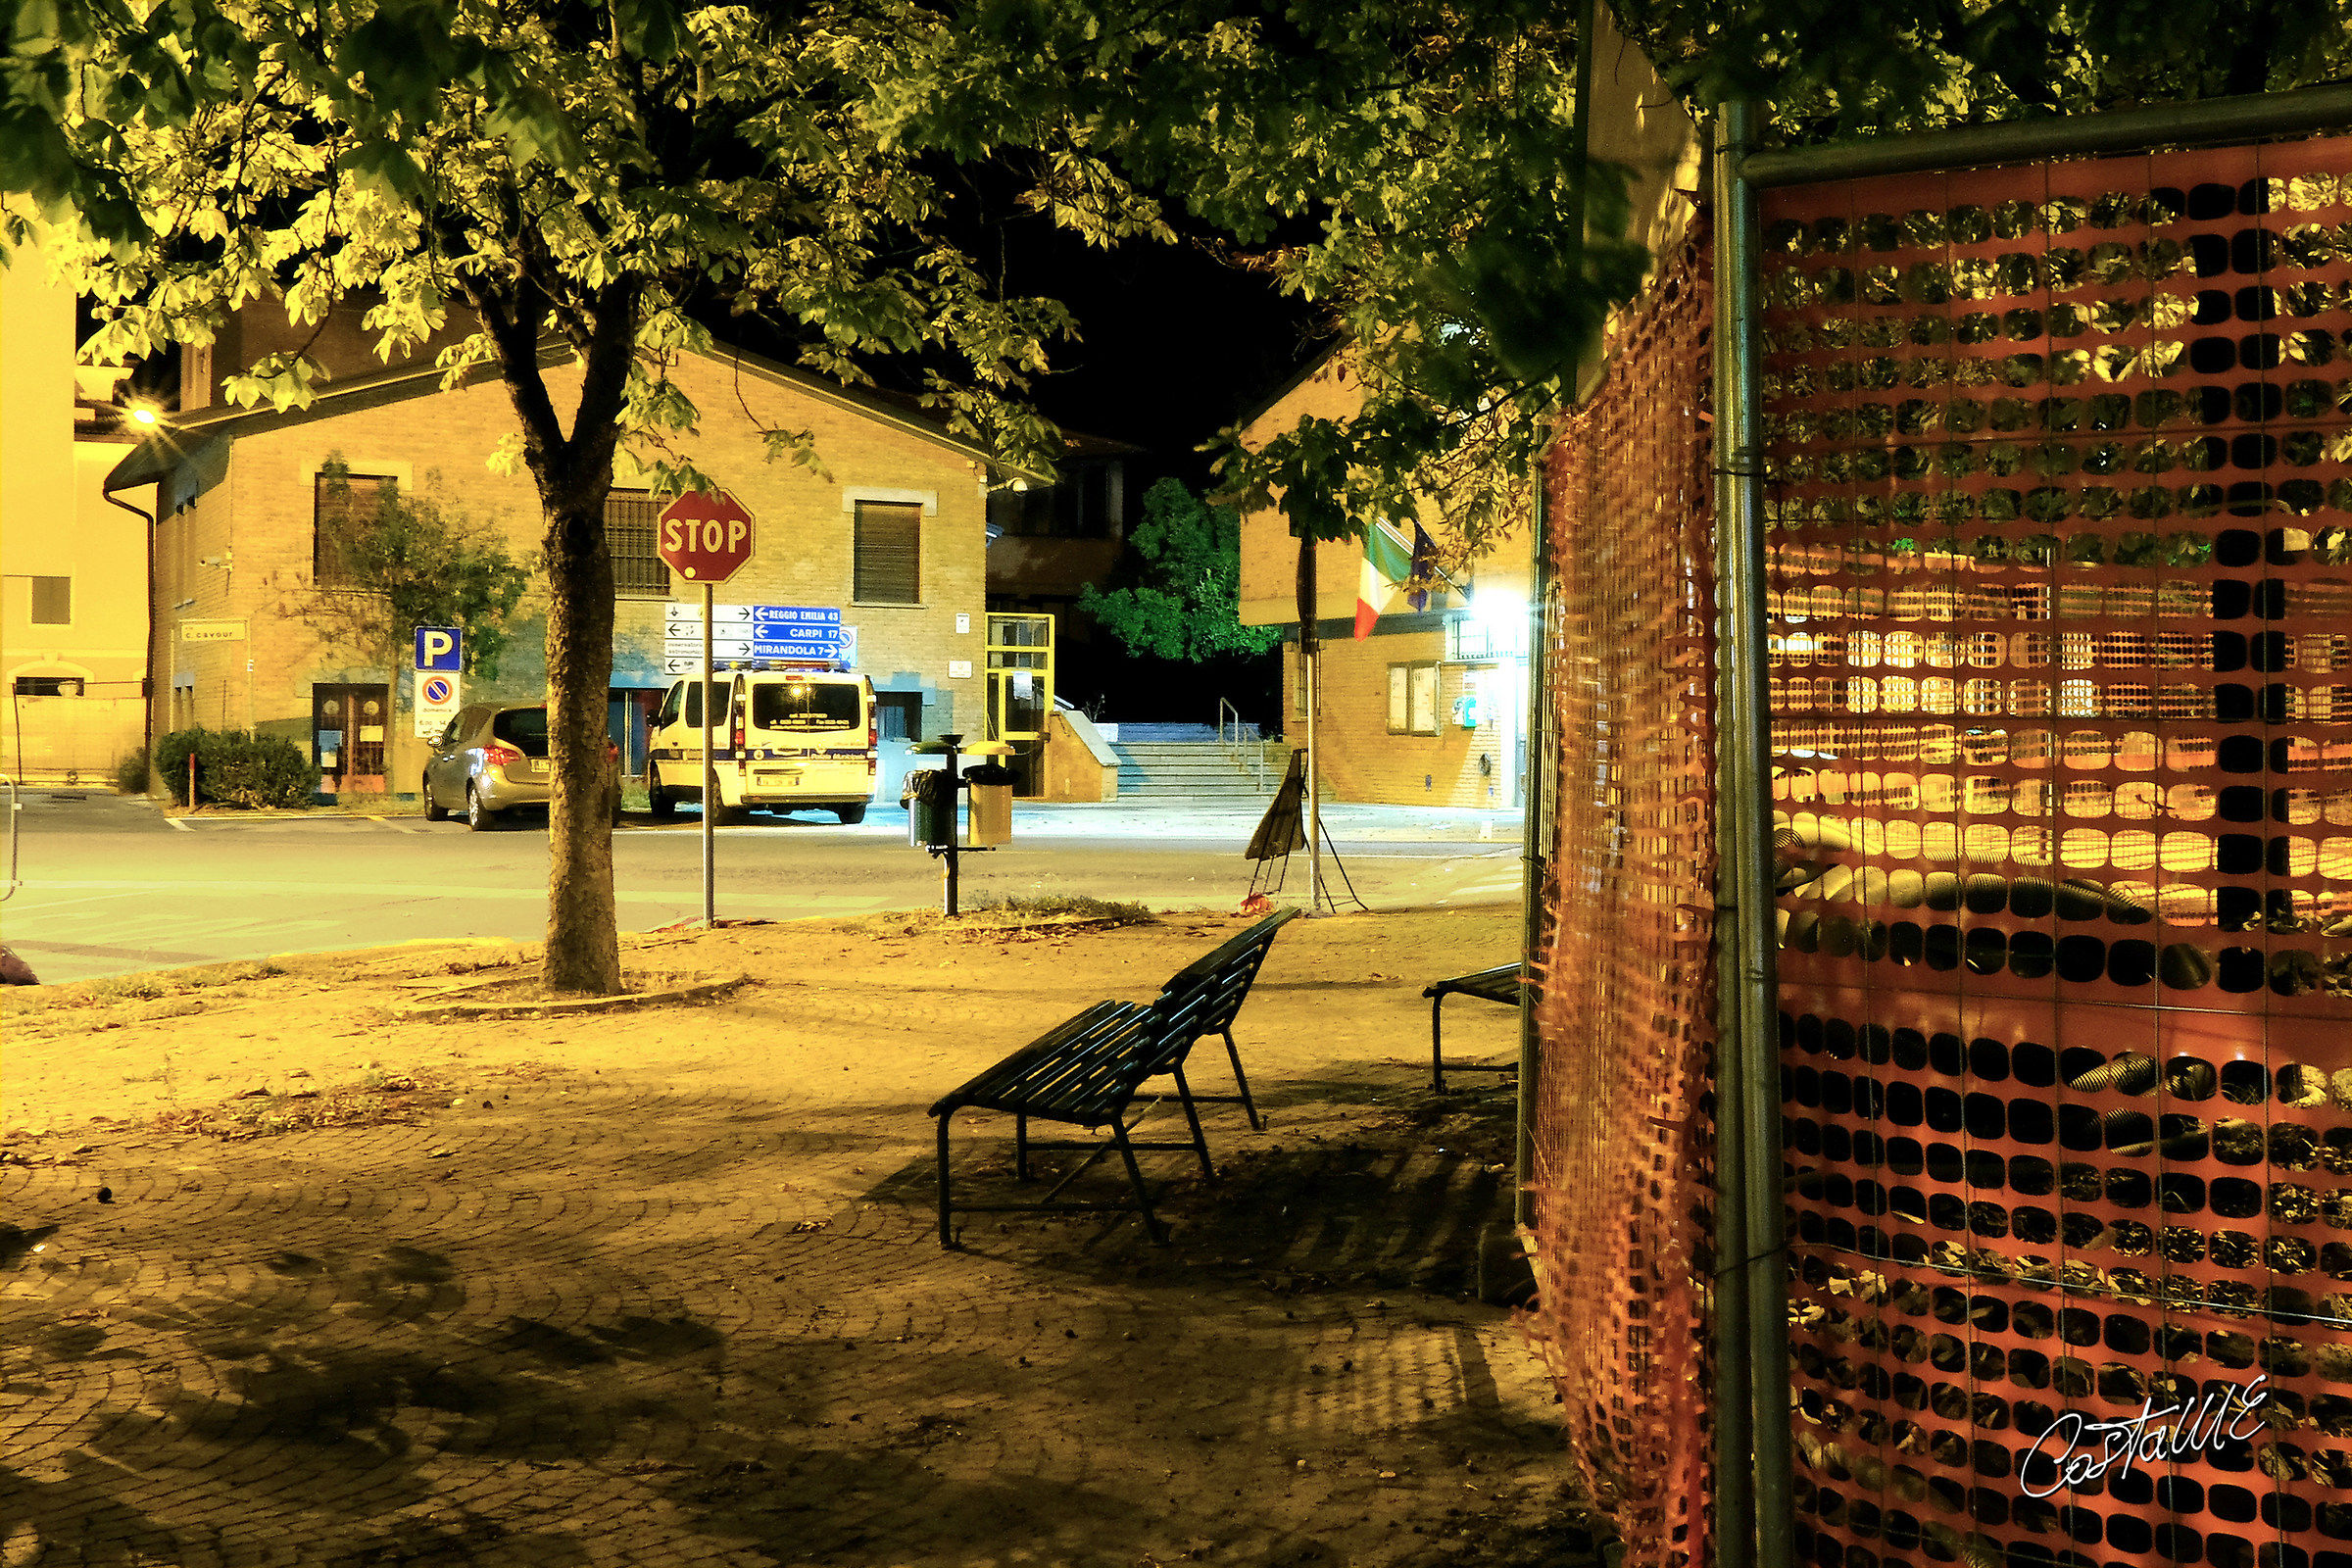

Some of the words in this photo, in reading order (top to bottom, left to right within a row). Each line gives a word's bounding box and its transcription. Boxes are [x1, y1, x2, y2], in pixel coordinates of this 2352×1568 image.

[665, 518, 747, 554] STOP
[768, 610, 798, 620] REGGIO
[801, 611, 826, 621] EMILIA
[828, 612, 839, 621] 43
[790, 628, 822, 638] CARPI
[828, 629, 839, 639] 17
[424, 631, 454, 667] P
[754, 644, 816, 656] MIRANDOLA
[817, 647, 825, 656] 7
